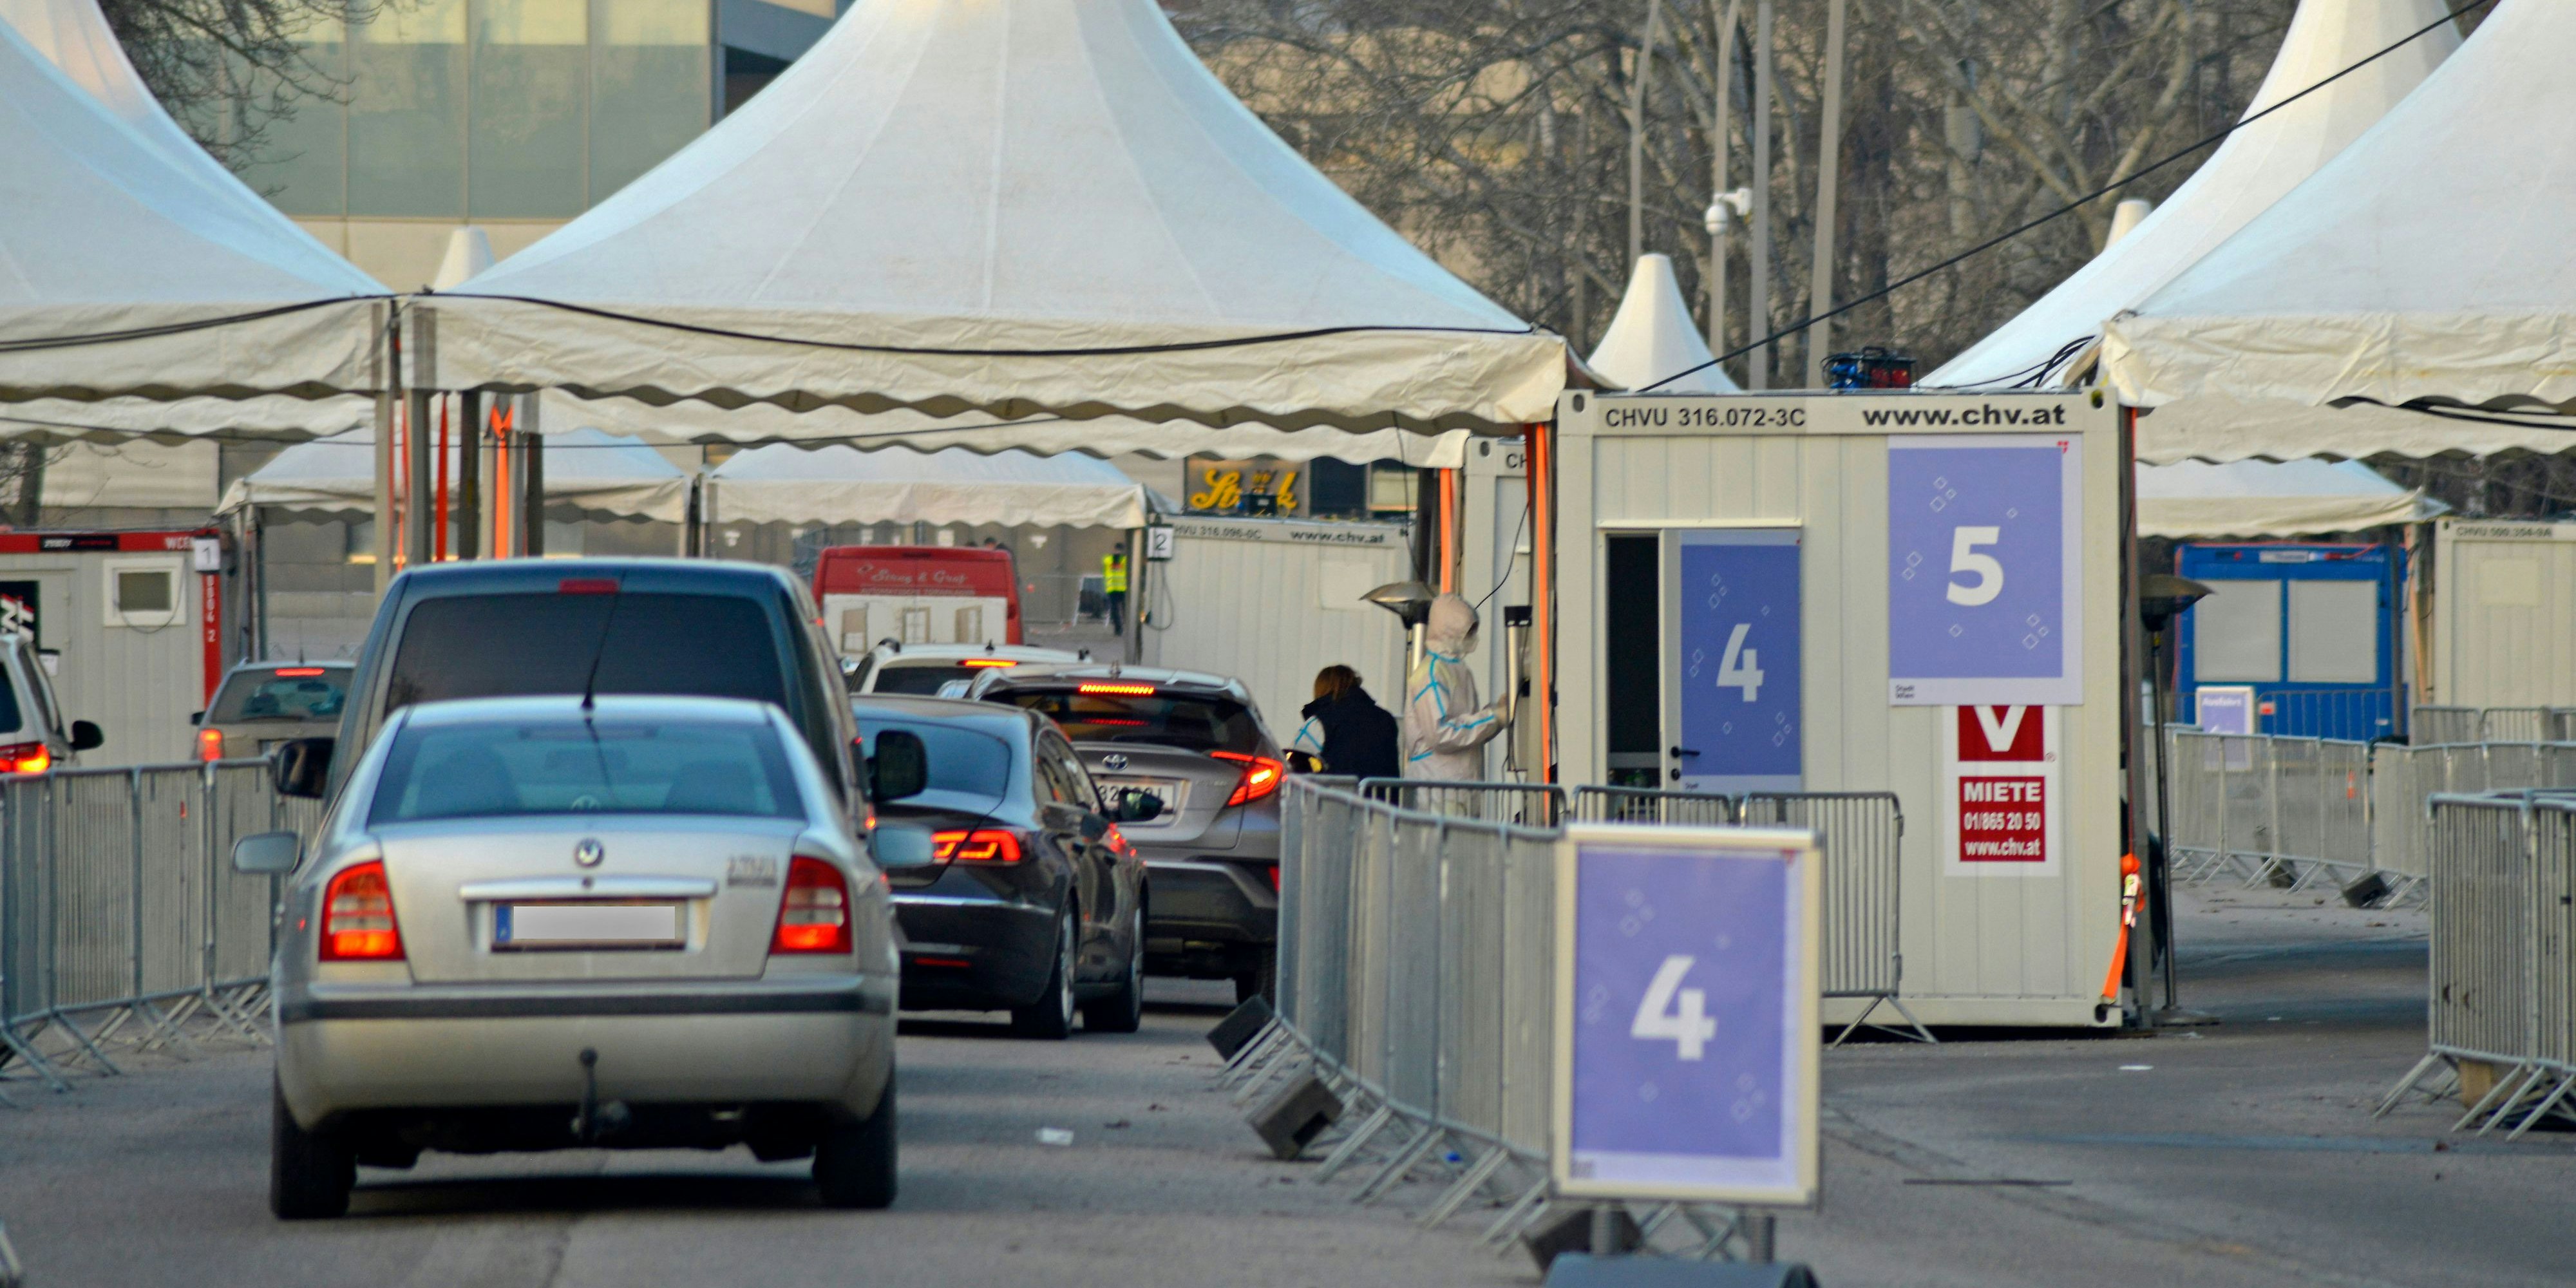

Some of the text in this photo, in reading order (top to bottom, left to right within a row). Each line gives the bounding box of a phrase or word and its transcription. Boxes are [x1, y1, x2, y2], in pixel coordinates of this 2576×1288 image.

[1605, 408, 1805, 428] CHVU 316.072-3C
[1863, 404, 2065, 425] www.chv.at
[1156, 534, 1166, 551] 2
[1290, 529, 1385, 544] www.chv.at
[201, 546, 211, 565] 1
[1947, 526, 2003, 606] 5
[1717, 623, 1764, 702] 4
[1964, 782, 2041, 802] MIETE
[1964, 812, 2041, 831] 01/865 20 50
[1965, 837, 2040, 856] www.chv.at
[1631, 955, 1717, 1061] 4
